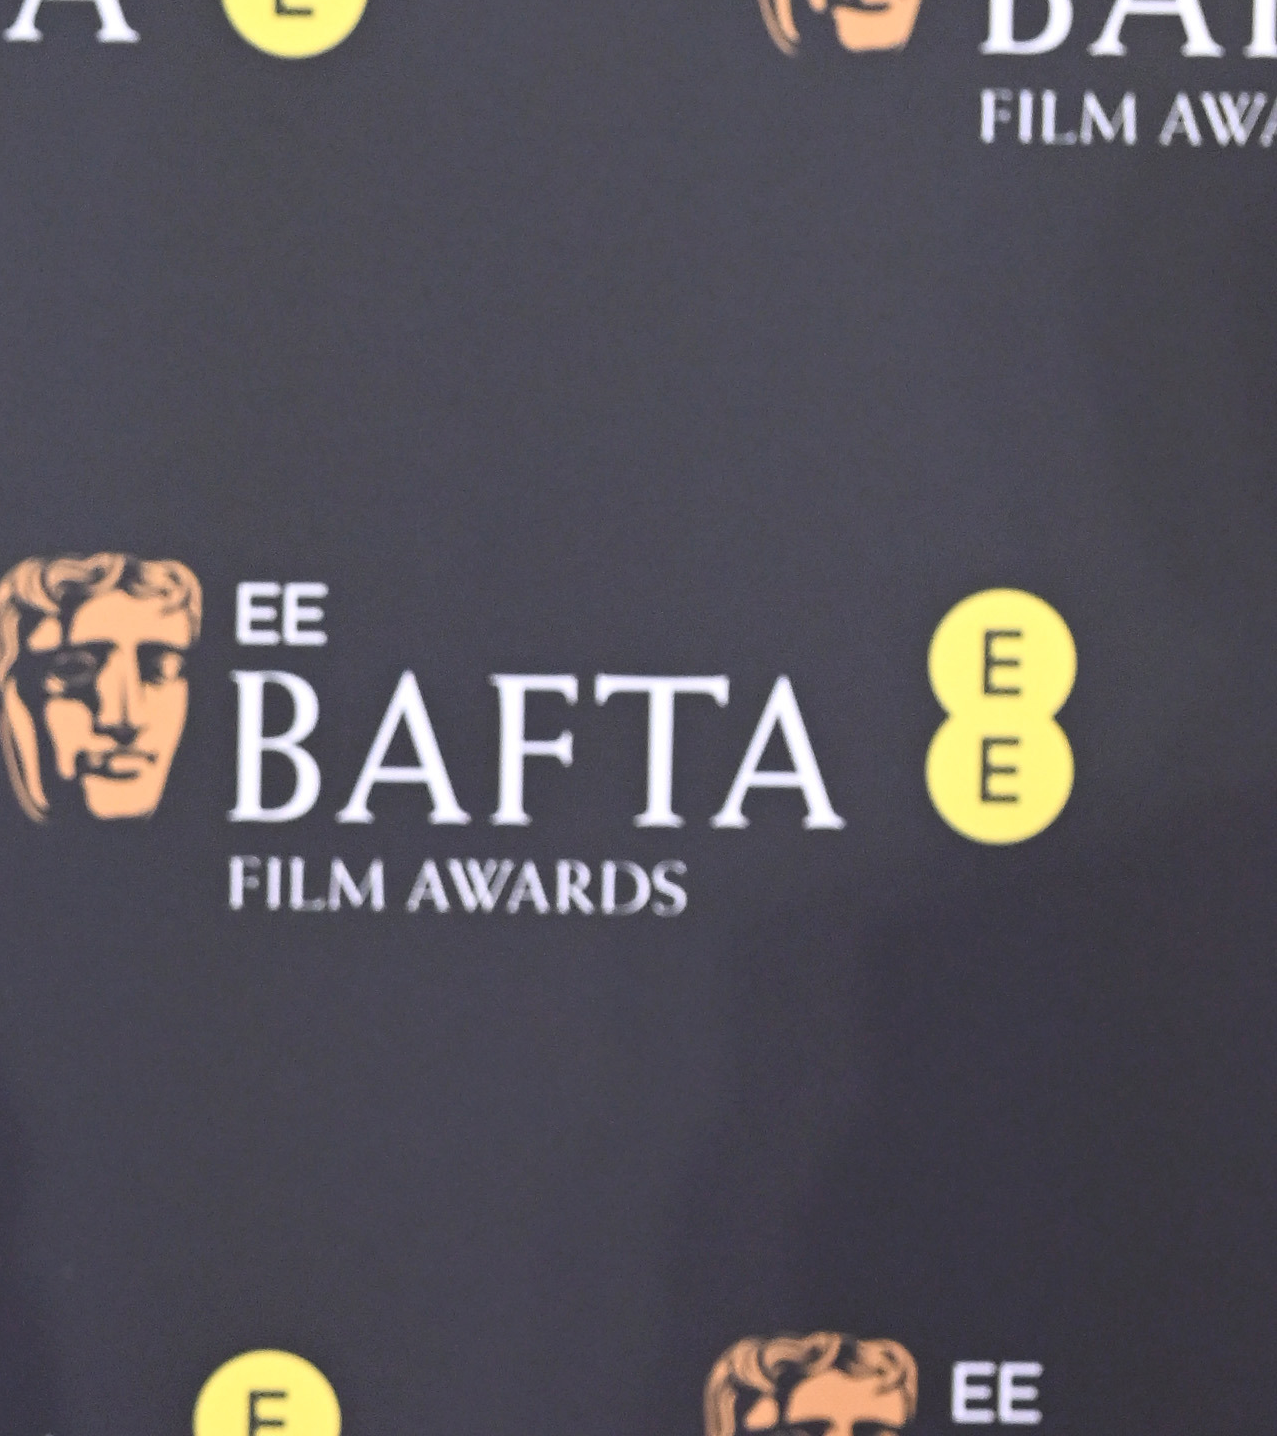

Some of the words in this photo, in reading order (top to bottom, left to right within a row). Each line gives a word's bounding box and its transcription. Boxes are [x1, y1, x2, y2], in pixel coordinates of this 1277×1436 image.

[980, 89, 1137, 145] FILM
[235, 582, 329, 646] EE
[229, 670, 845, 829] BAFTA
[229, 856, 385, 911] FILM
[407, 858, 687, 915] AWARDS
[951, 1361, 1042, 1424] EE
